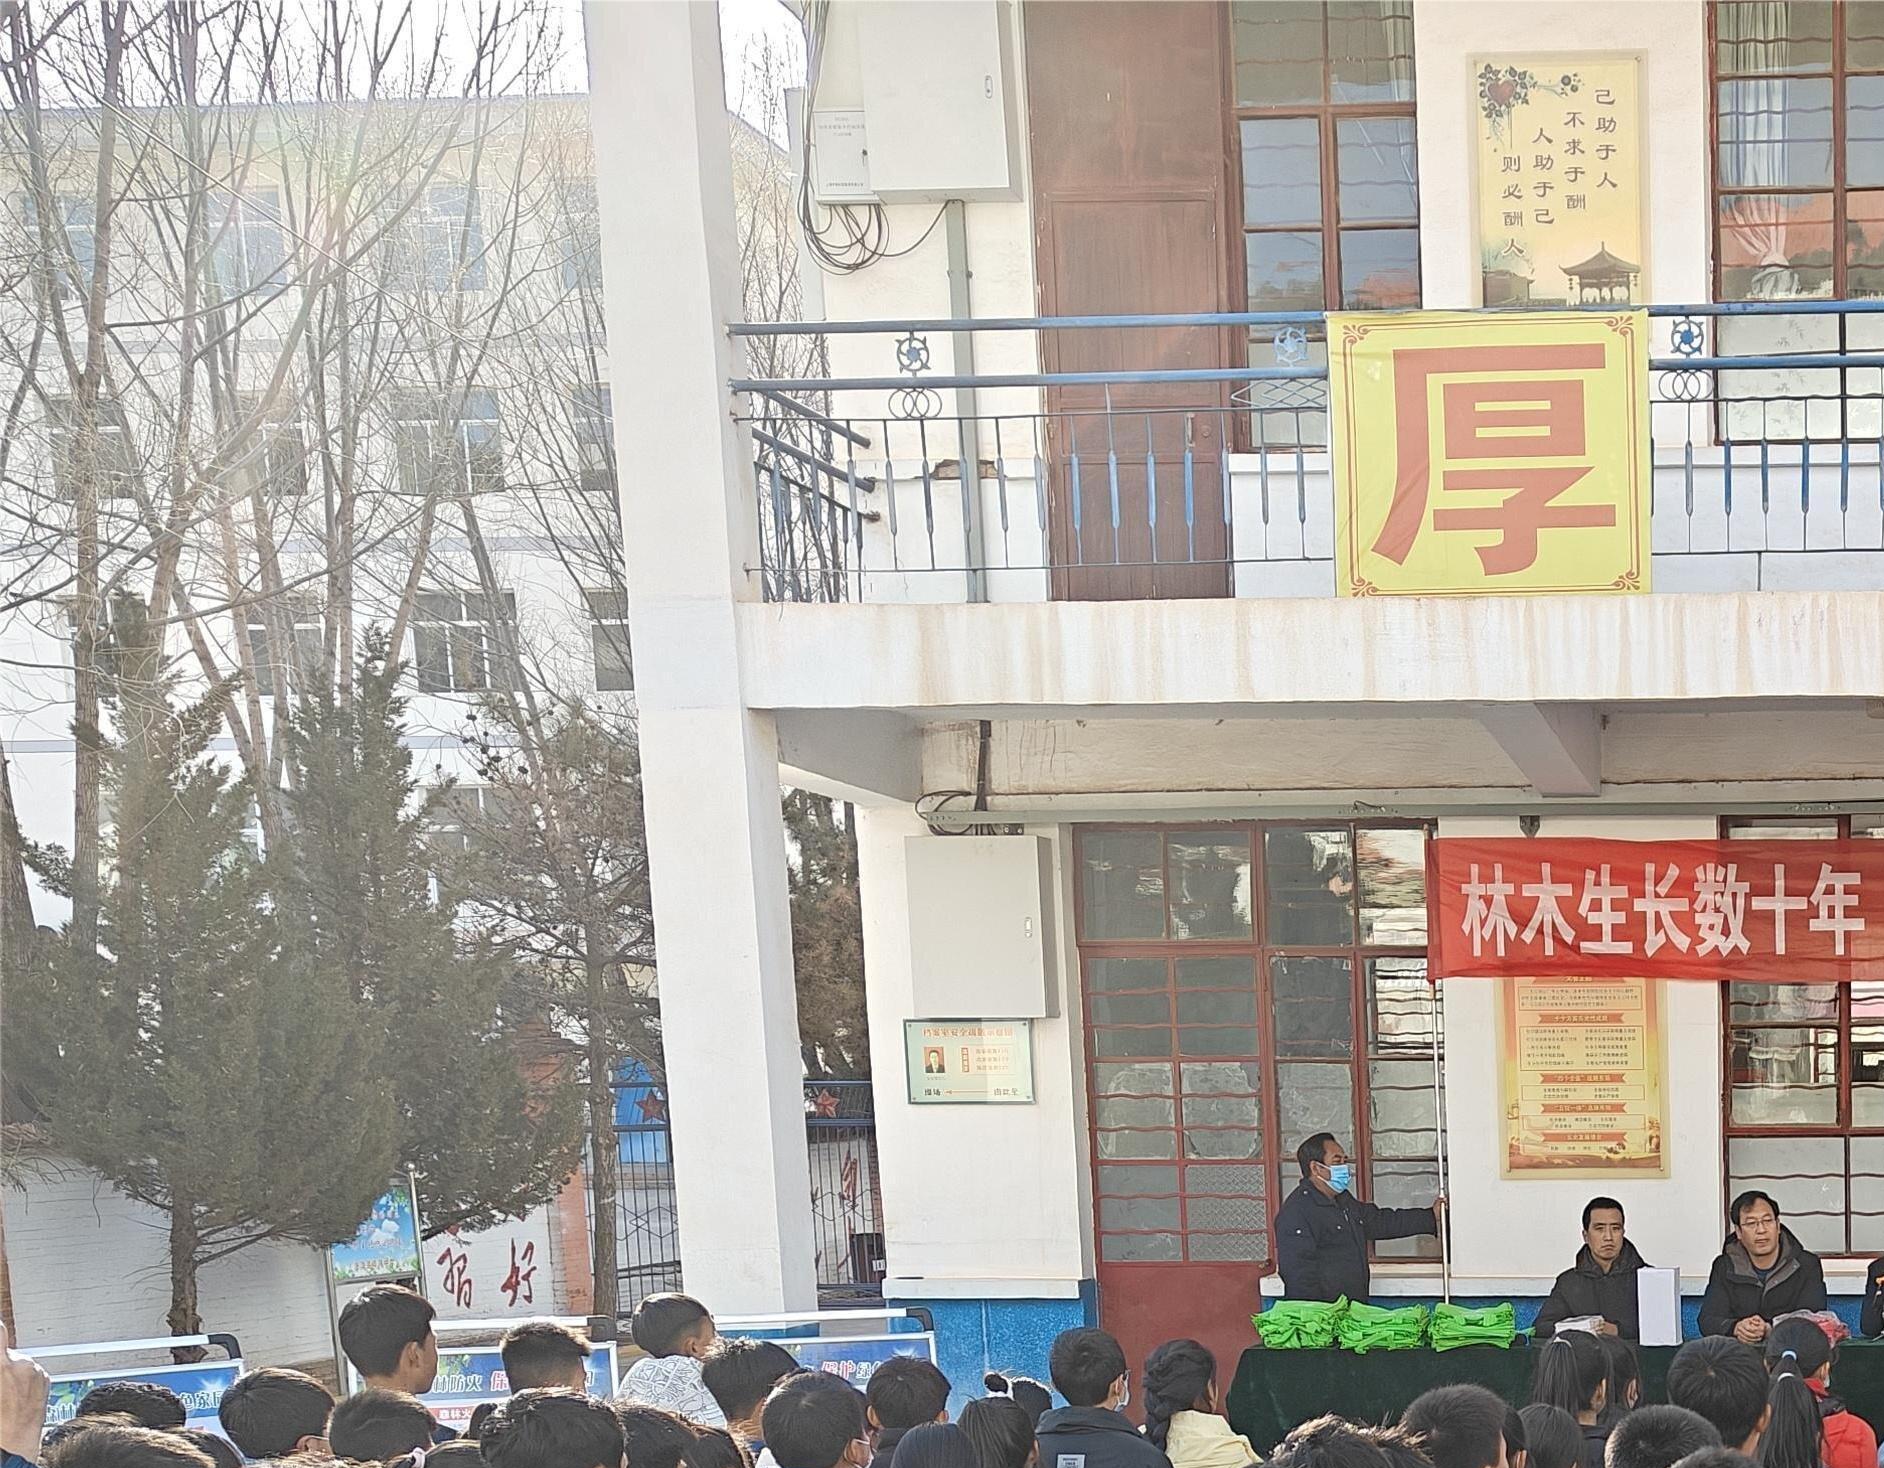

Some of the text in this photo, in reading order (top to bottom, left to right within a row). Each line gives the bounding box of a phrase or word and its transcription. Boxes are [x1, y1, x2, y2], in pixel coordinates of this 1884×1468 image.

[1531, 127, 1555, 226] 人助于己
[1563, 111, 1587, 210] 不求于酬
[1594, 88, 1618, 190] 己助于人
[1500, 154, 1525, 257] 则必酬人
[1371, 342, 1616, 576] 厚
[1460, 861, 1866, 958] 林木生长数十年
